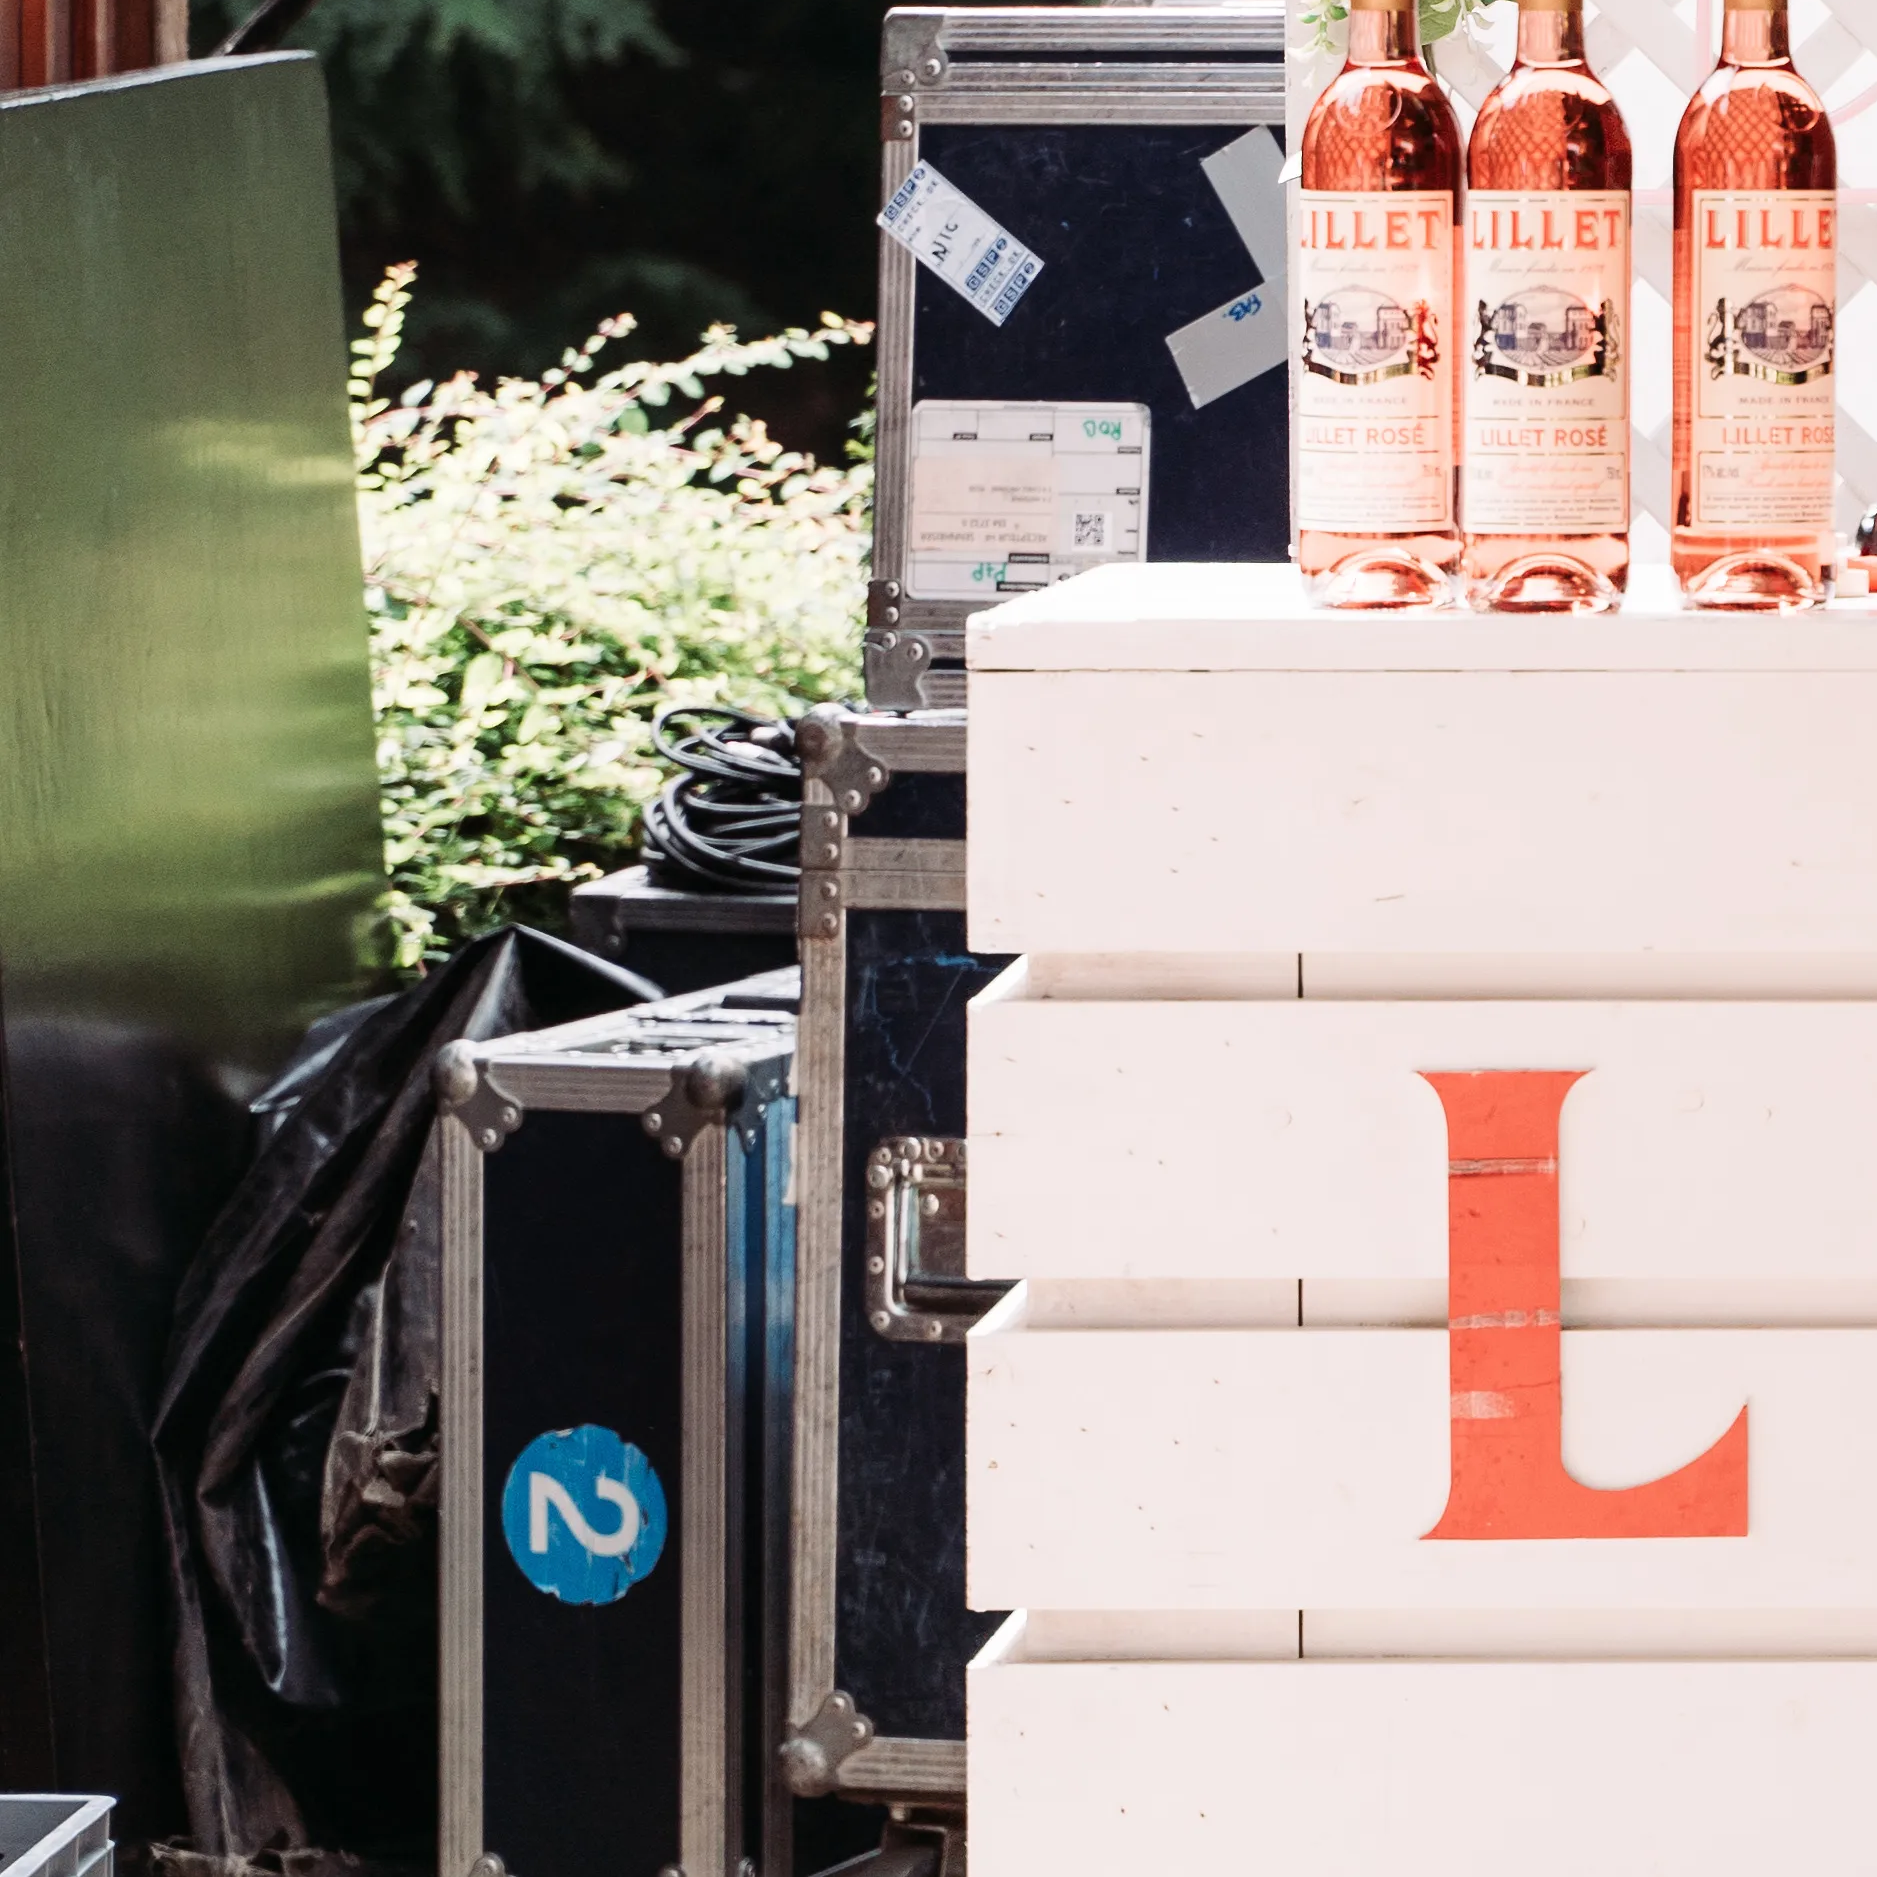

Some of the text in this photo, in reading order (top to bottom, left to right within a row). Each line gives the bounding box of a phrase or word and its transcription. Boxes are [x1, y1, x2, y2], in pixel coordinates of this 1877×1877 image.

[1300, 210, 1441, 250] ILLET
[1473, 210, 1621, 250] LILLET
[1705, 209, 1837, 250] LILLE
[1366, 421, 1425, 445] ROSÉ
[1481, 424, 1608, 447] LILLET ROSÉ
[1722, 426, 1795, 445] LILLET
[530, 1472, 640, 1555] 2
